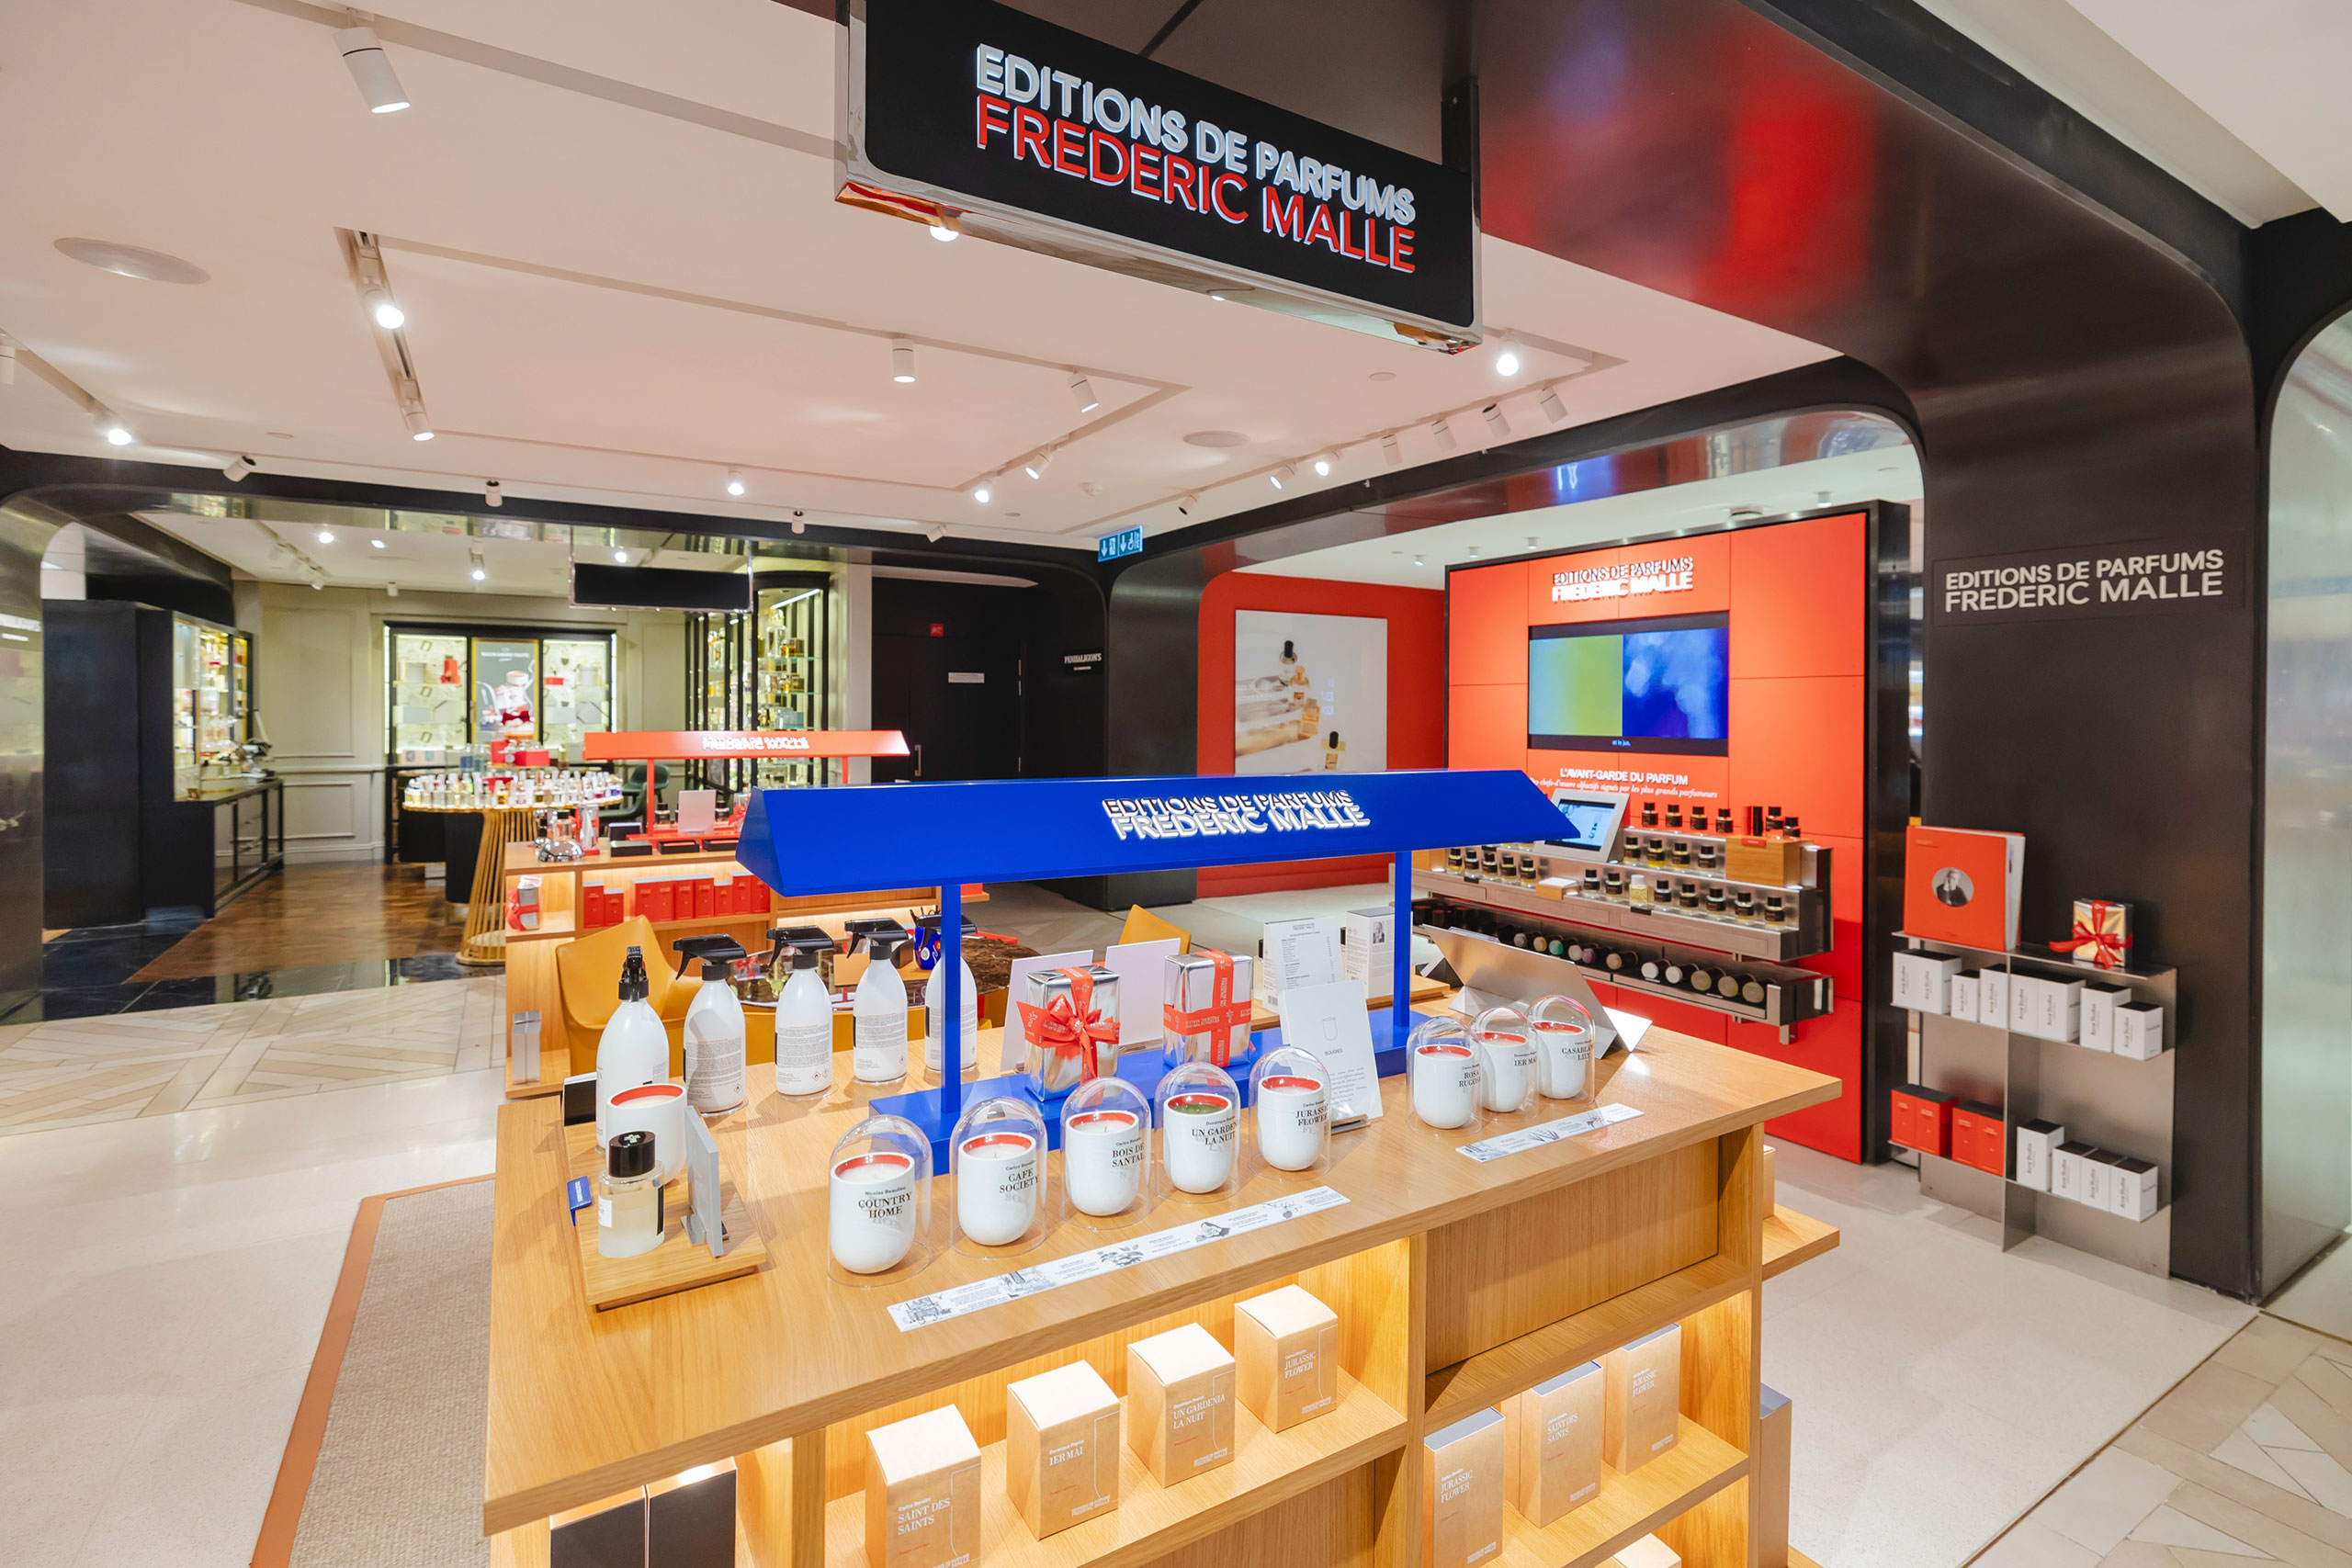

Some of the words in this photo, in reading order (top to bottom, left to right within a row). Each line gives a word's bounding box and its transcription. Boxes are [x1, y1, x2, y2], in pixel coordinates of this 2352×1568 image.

[975, 42, 1188, 153] EDITIONS
[1195, 120, 1248, 173] DE
[1256, 141, 1417, 225] PARFUMS
[976, 93, 1250, 224] FREDERIC
[1262, 185, 1416, 274] MALLE
[1553, 566, 1610, 585] EDITIONS
[1610, 564, 1629, 578] DE
[1629, 557, 1693, 576] PARFUMS
[1945, 564, 2052, 591] EDITIONS
[2056, 561, 2090, 582] DE
[2096, 548, 2224, 579] PARFUMS
[1552, 579, 1629, 603] FREDERIC
[1630, 571, 1693, 594] MALLE
[1945, 581, 2090, 613] FREDERIC
[2099, 570, 2224, 604] MALLE
[1560, 768, 1628, 783] L'AVANT-GARDE
[1630, 771, 1645, 784] DU
[1646, 773, 1689, 786] PARFUM
[1619, 784, 1630, 794] par
[1631, 784, 1640, 793] les
[1640, 785, 1654, 795] plus
[1656, 787, 1678, 797] grands
[1679, 789, 1718, 799] parfumeurs
[1102, 795, 1219, 818] EDITIONS
[1218, 794, 1256, 812] DE
[1253, 790, 1354, 810] PARFUMS
[1111, 810, 1268, 840] FREDERIC
[1267, 805, 1371, 832] MALLE
[1192, 1129, 1204, 1137] UN
[1207, 1122, 1237, 1136] GARDEN
[1113, 1146, 1134, 1157] BOIS
[1135, 1142, 1145, 1153] DE
[1205, 1137, 1216, 1145] LA
[1112, 1153, 1144, 1168] SANTAL
[1000, 1175, 1039, 1193] SOCIETY
[1009, 1168, 1034, 1182] CAFE
[858, 1191, 912, 1209] COUNTRY
[869, 1205, 903, 1219] HOME
[1284, 1361, 1314, 1379] FLOWER
[1173, 1409, 1185, 1419] UN
[1186, 1393, 1226, 1415] GARDENIA
[1173, 1419, 1184, 1429] LA
[1186, 1411, 1205, 1426] NUIT
[1049, 1453, 1066, 1467] 1ER
[1067, 1446, 1083, 1461] MAI
[1441, 1482, 1470, 1504] FLOWER
[898, 1505, 930, 1524] SAINT
[932, 1497, 951, 1513] DES
[898, 1515, 935, 1536] SAINTS
